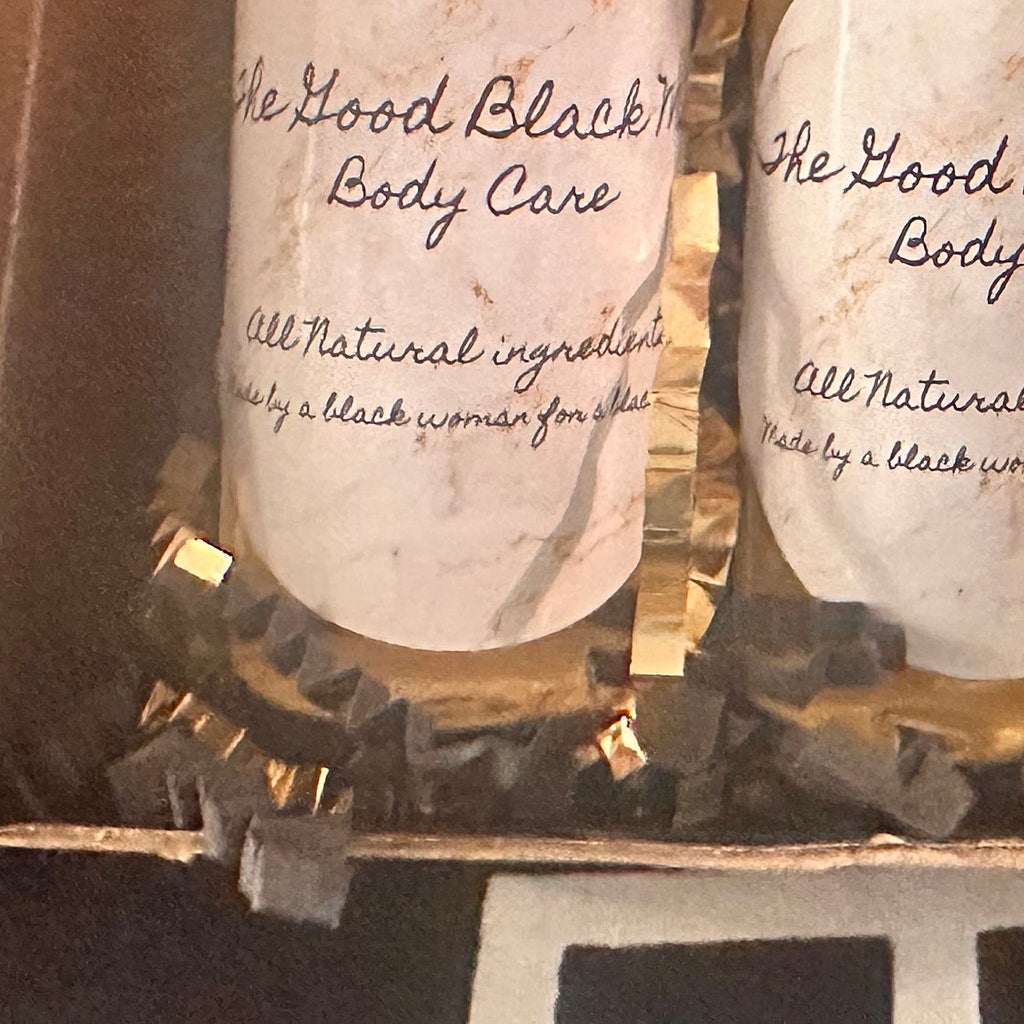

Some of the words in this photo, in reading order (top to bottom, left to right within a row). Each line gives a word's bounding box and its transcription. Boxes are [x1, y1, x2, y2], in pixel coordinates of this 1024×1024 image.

[287, 61, 454, 135] Good
[465, 75, 651, 139] Black
[761, 120, 846, 184] The
[843, 127, 1012, 195] Good
[328, 155, 467, 249] Body
[486, 164, 621, 216] Care
[889, 216, 1024, 304] Body
[246, 305, 300, 350] All
[302, 317, 485, 364] Natural
[794, 360, 860, 403] All
[298, 401, 316, 420] a
[323, 391, 411, 426] black
[417, 409, 530, 429] woman
[531, 395, 588, 449] for
[760, 414, 819, 455] Made
[823, 432, 852, 481] by
[860, 450, 880, 468] a
[887, 441, 977, 474] black
